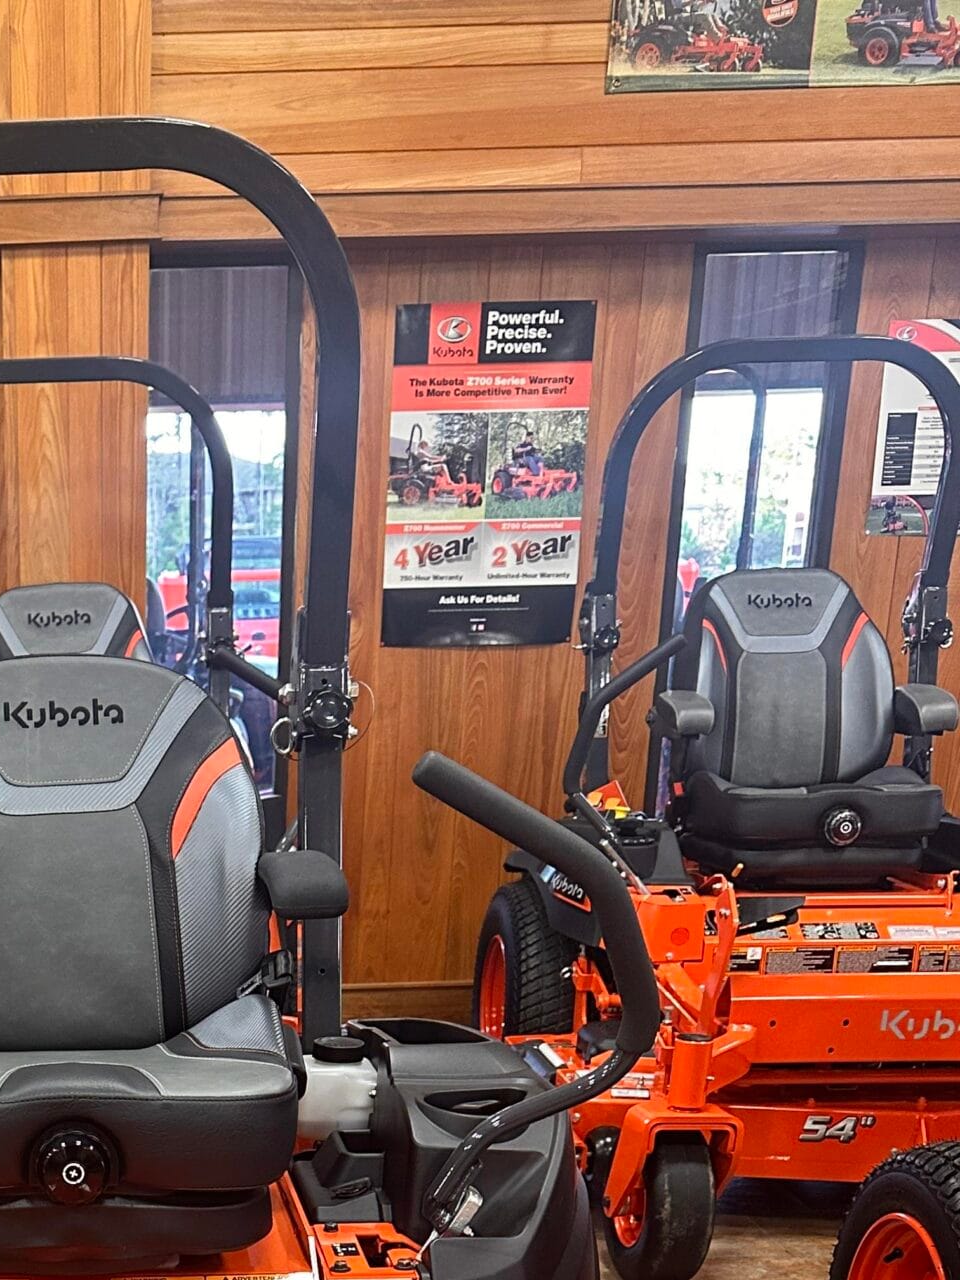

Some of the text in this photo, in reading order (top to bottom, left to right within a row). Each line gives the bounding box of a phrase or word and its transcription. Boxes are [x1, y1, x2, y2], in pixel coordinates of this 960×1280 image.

[487, 309, 565, 325] Powerful.
[486, 325, 553, 339] Precise.
[432, 346, 474, 358] Kubota
[485, 340, 547, 354] Proven.
[409, 375, 575, 387] The Kubota Z700 Series Warranty
[414, 386, 568, 399] Is More Competitive Than Ever!
[392, 534, 475, 571] 4 Year
[491, 532, 573, 568] 2 Year
[432, 574, 463, 582] Warranty
[539, 572, 570, 580] Warranty
[439, 594, 521, 605] Ask Us For Details!
[747, 592, 812, 609] Kubota
[27, 609, 91, 628] Kubota
[3, 698, 124, 729] Kubota
[551, 873, 584, 899] Kubota
[879, 1008, 960, 1040] Kub
[798, 1114, 877, 1145] 54"
